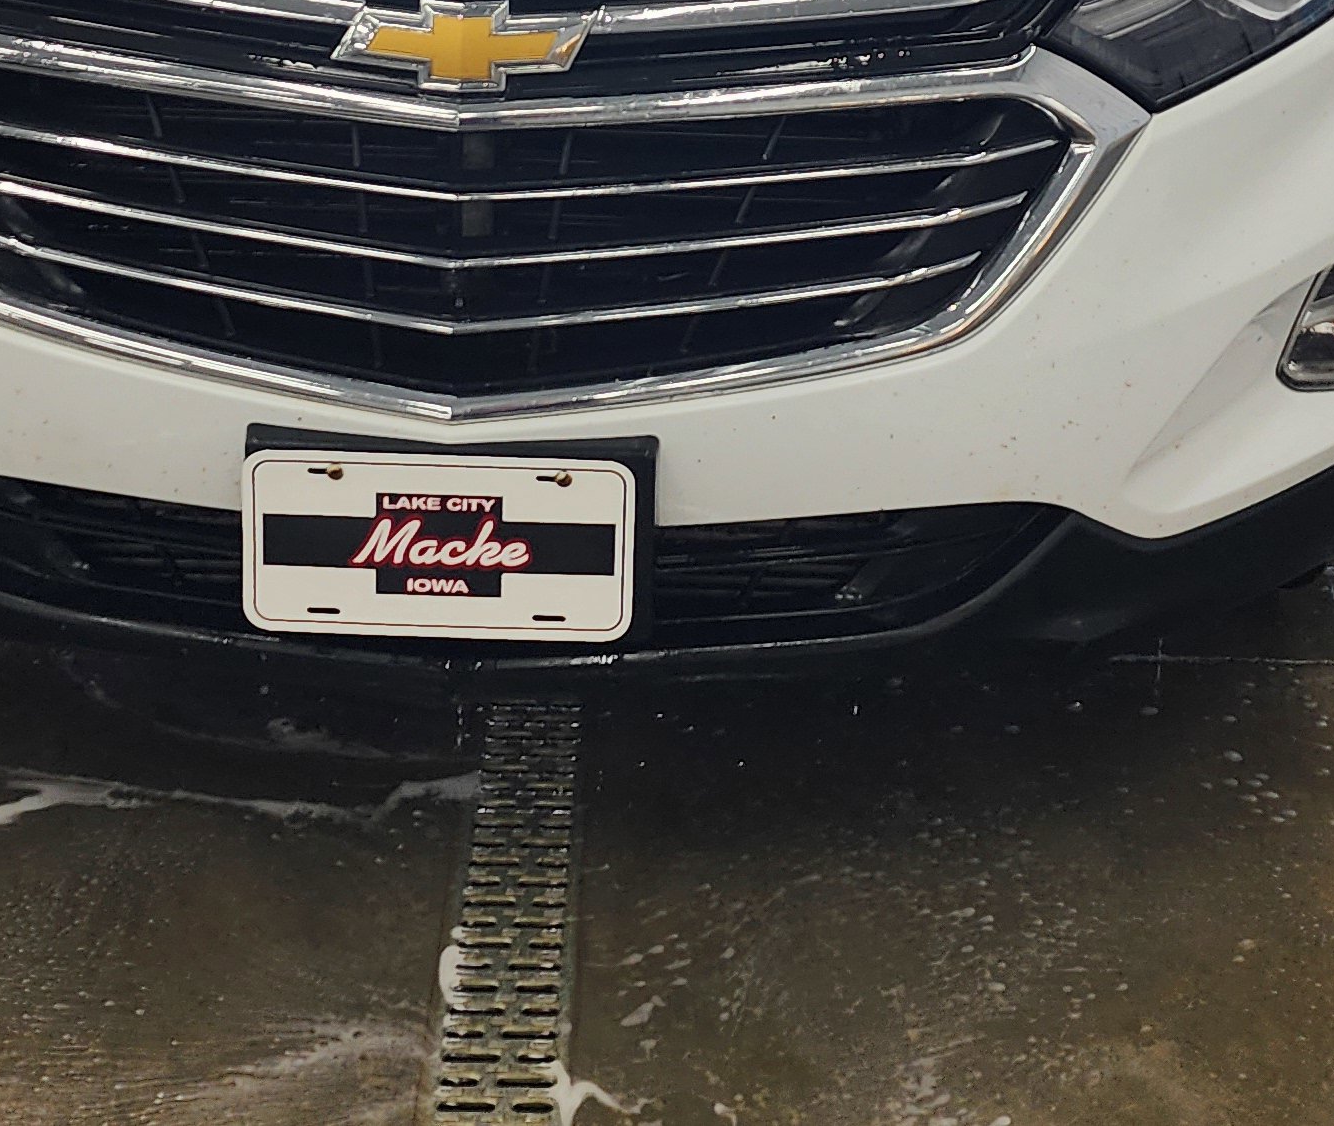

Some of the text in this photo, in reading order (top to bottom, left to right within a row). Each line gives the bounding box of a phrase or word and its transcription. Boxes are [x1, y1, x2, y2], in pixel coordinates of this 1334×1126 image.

[382, 495, 496, 514] LAKE CITY
[352, 517, 531, 568] Macke
[406, 577, 469, 594] IOWA
